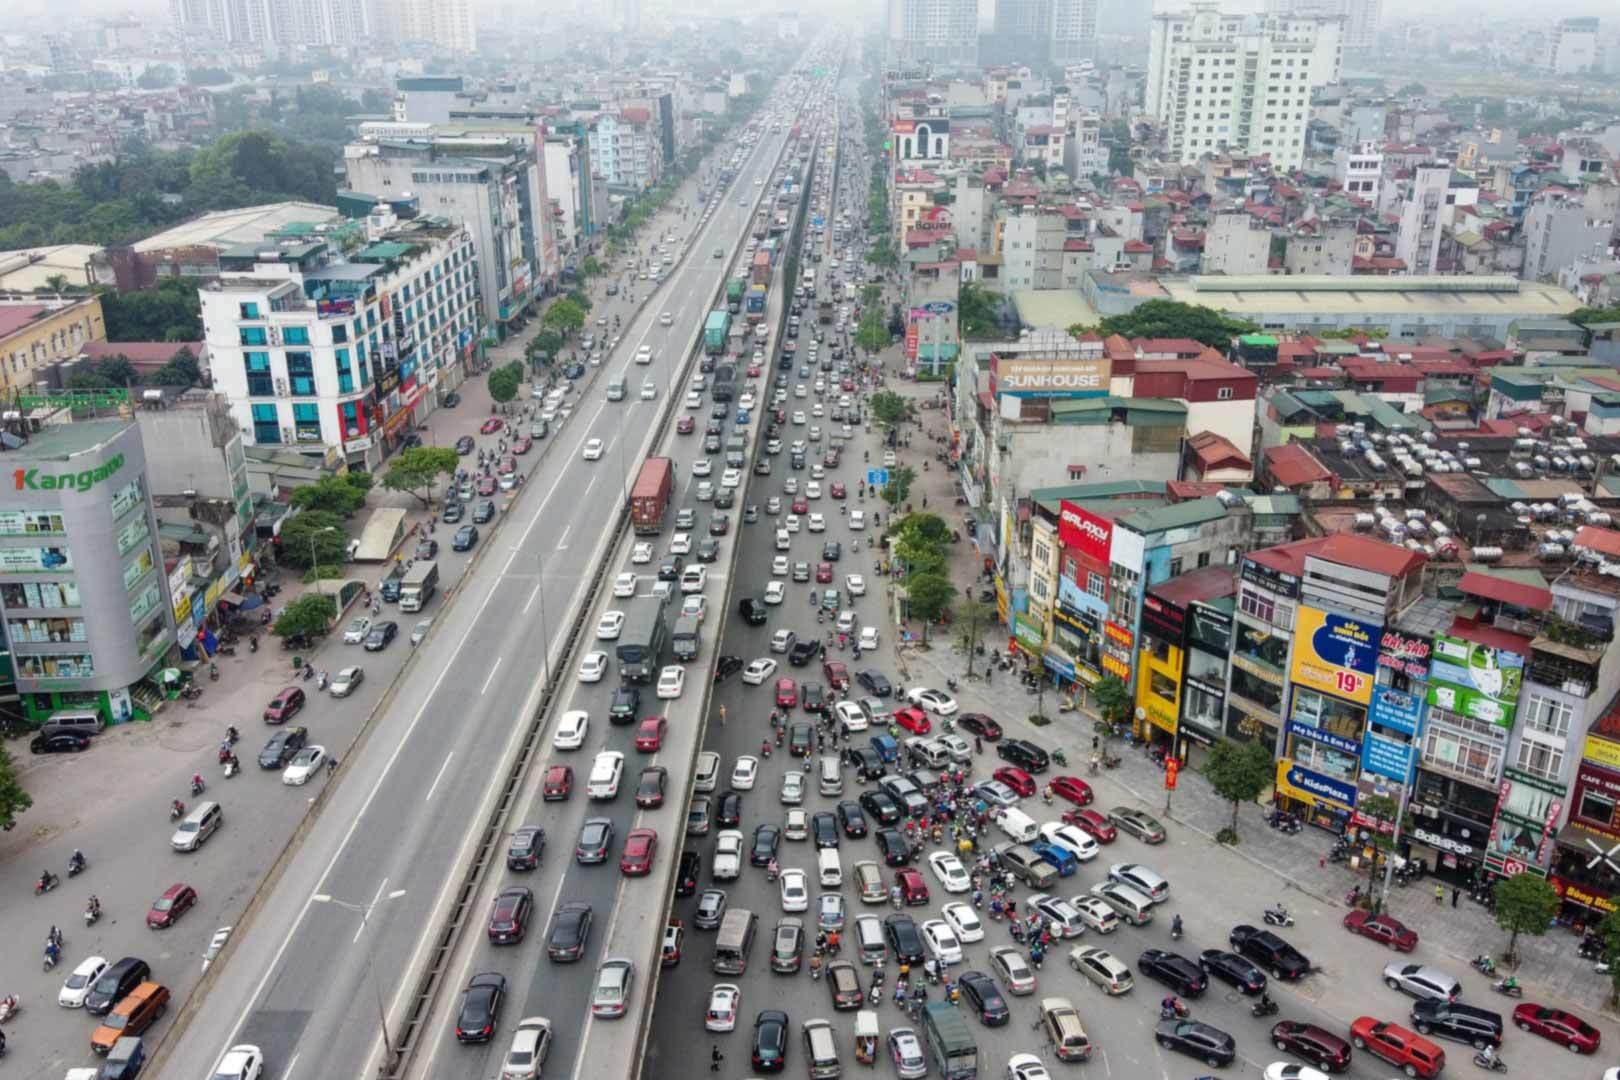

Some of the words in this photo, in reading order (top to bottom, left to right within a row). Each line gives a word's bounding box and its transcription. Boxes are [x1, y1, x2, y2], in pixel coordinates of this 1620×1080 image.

[1003, 375, 1101, 387] SUNHOUSE
[1061, 510, 1109, 541] GALAXY
[1303, 778, 1350, 801] KidsPlaza
